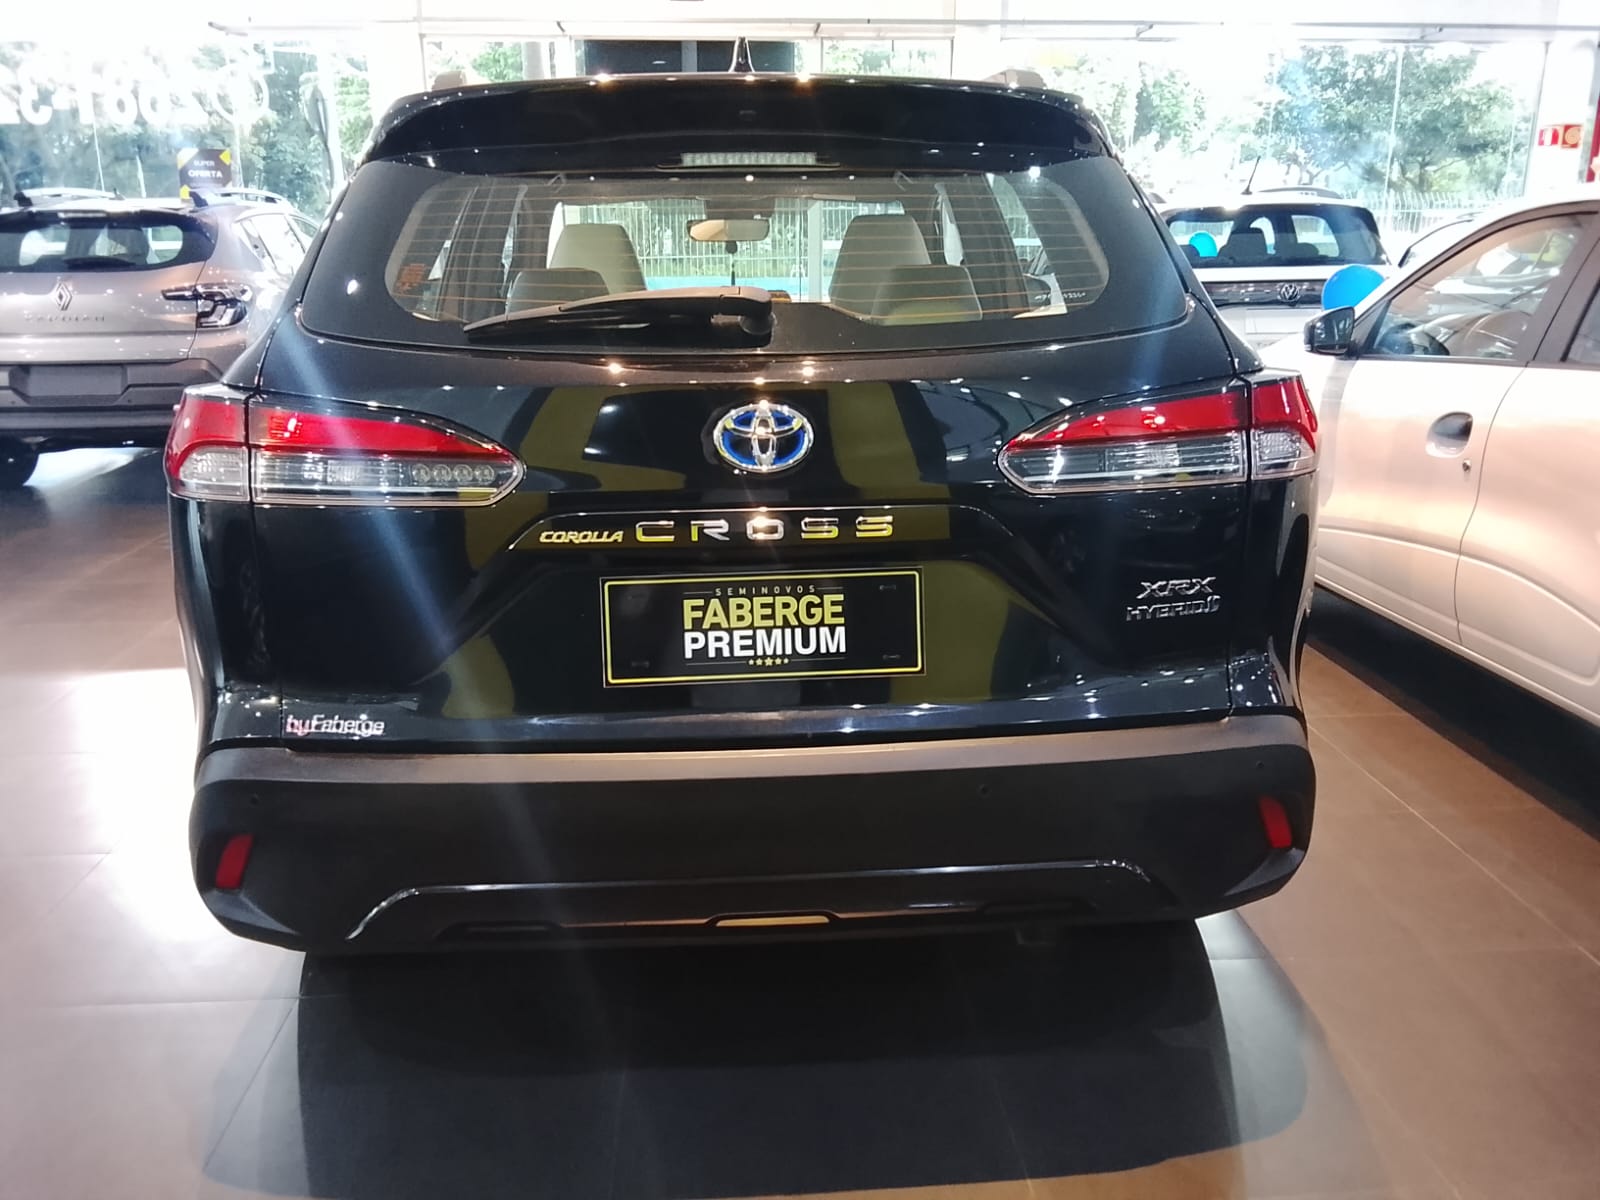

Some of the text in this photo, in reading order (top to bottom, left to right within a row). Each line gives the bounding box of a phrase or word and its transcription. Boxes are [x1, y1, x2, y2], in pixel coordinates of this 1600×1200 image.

[188, 169, 223, 178] OFERTA
[539, 515, 893, 544] COROLLA CROSS
[716, 585, 815, 596] SEMINOVOS
[683, 594, 845, 630] FABERGE
[684, 626, 847, 659] PREMIUM
